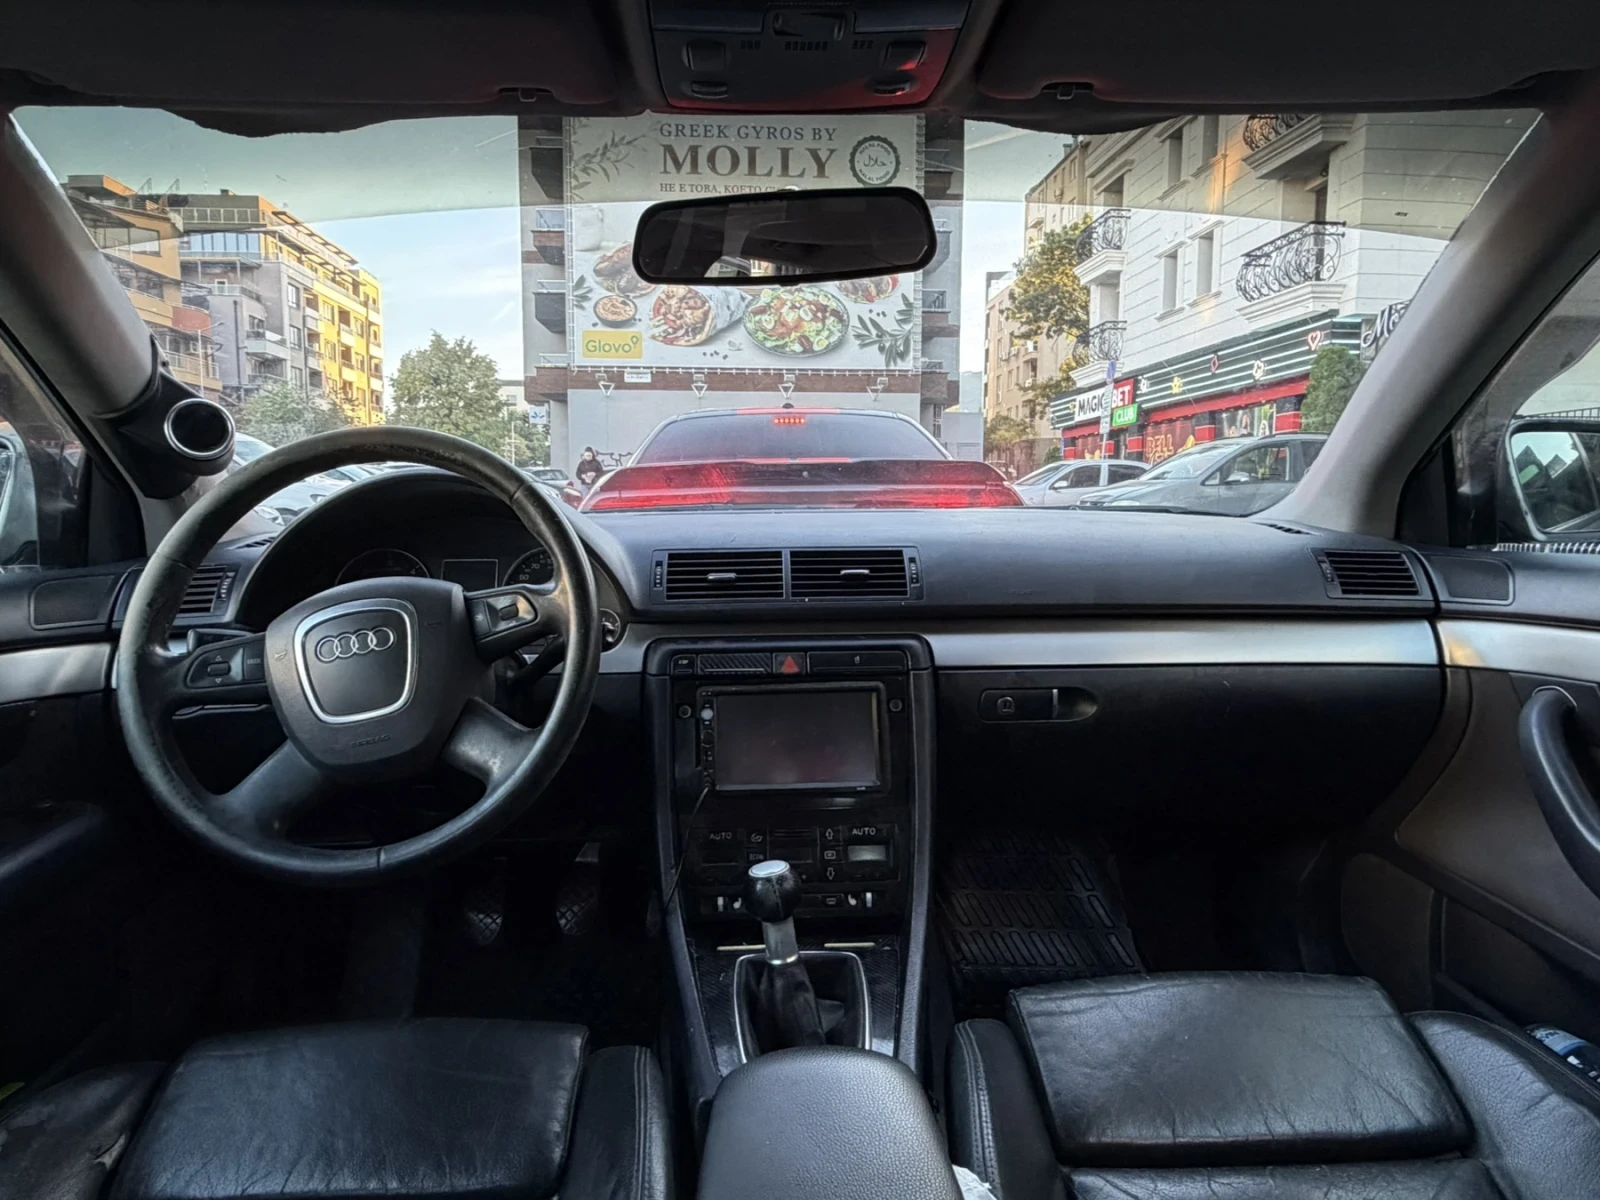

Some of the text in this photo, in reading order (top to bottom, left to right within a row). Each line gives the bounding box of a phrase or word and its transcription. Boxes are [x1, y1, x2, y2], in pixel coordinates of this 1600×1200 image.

[660, 123, 837, 141] GREEK GYROS BY
[659, 143, 837, 179] MOLLY
[660, 183, 676, 192] НЕ
[688, 184, 721, 195] ТОВА,
[585, 339, 632, 353] Glovo
[1112, 385, 1131, 409] BET
[1117, 406, 1134, 423] CLUB
[1146, 434, 1174, 457] BELL
[709, 832, 732, 840] AUTO
[852, 827, 876, 835] AUTO
